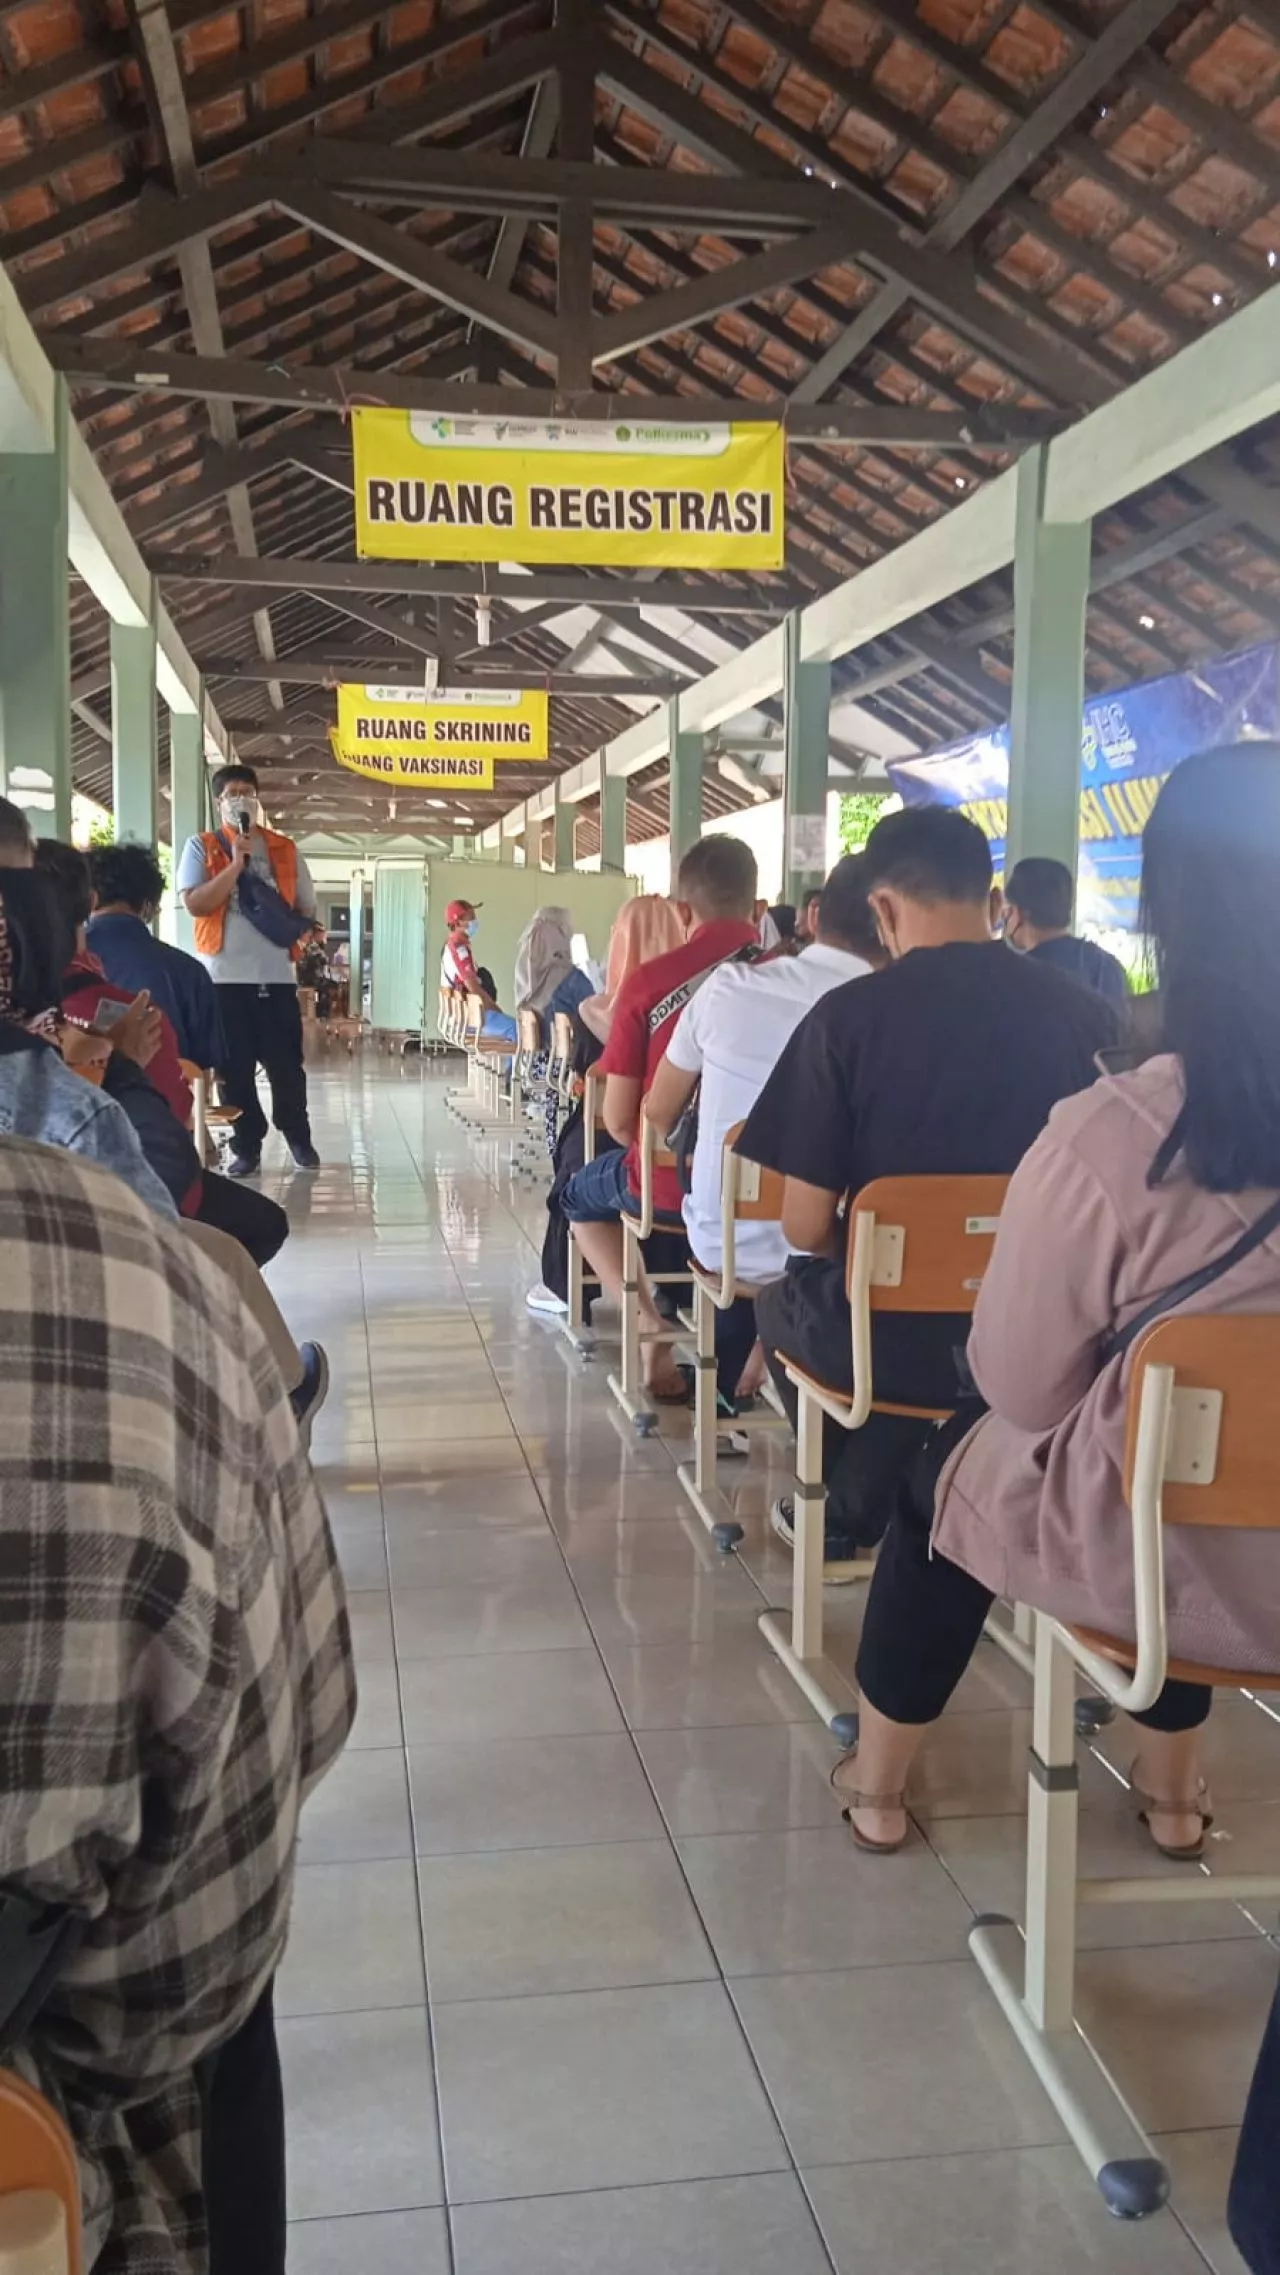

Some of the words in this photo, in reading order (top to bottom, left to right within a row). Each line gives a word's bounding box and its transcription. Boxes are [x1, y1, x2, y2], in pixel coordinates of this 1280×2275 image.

[368, 480, 512, 527] RUANG
[530, 486, 771, 533] REGISTRASI
[356, 718, 426, 741] RUANG
[434, 721, 531, 743] SKRINING
[342, 751, 393, 772] UANG
[400, 757, 483, 776] VAKSINASI
